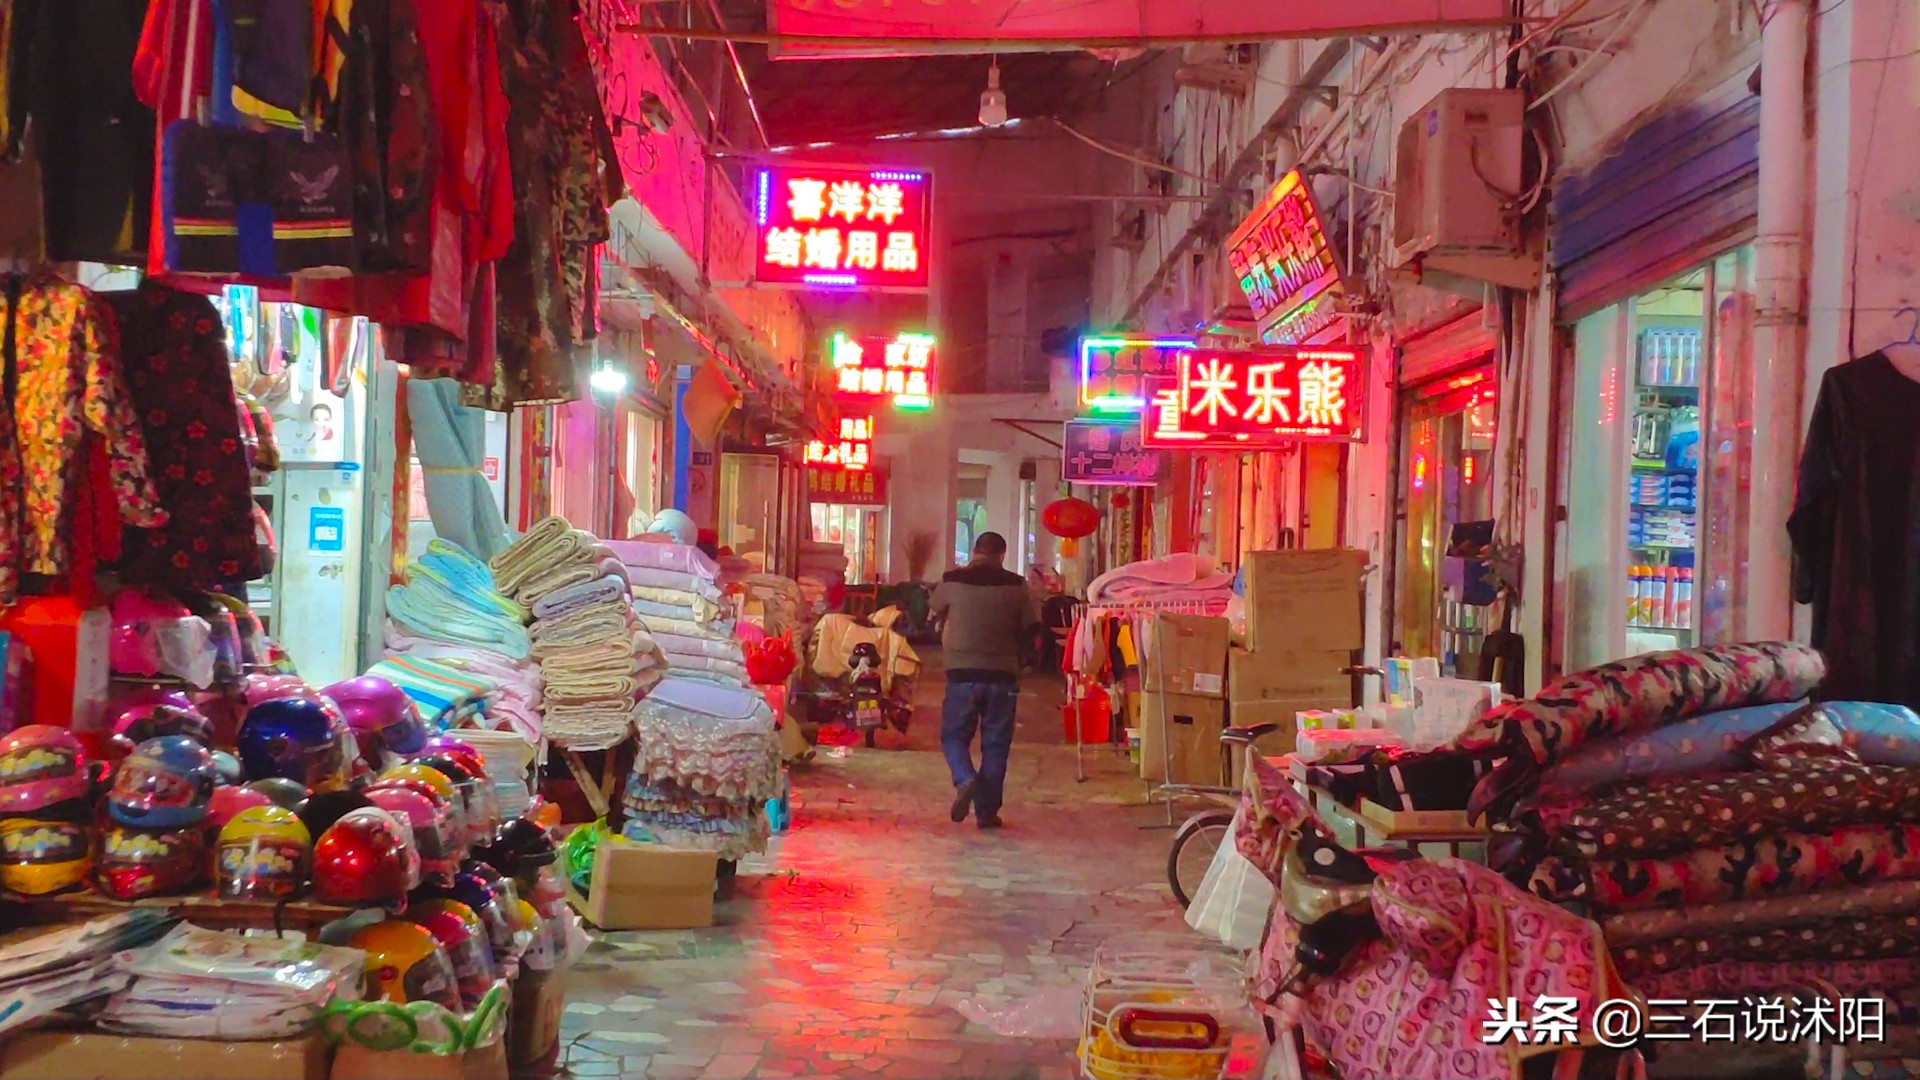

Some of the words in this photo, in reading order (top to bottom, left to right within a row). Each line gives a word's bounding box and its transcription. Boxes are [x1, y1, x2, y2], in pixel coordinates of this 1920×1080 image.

[787, 178, 904, 224] 喜洋洋
[765, 227, 917, 271] 结婚用品
[1190, 359, 1345, 425] 米乐熊
